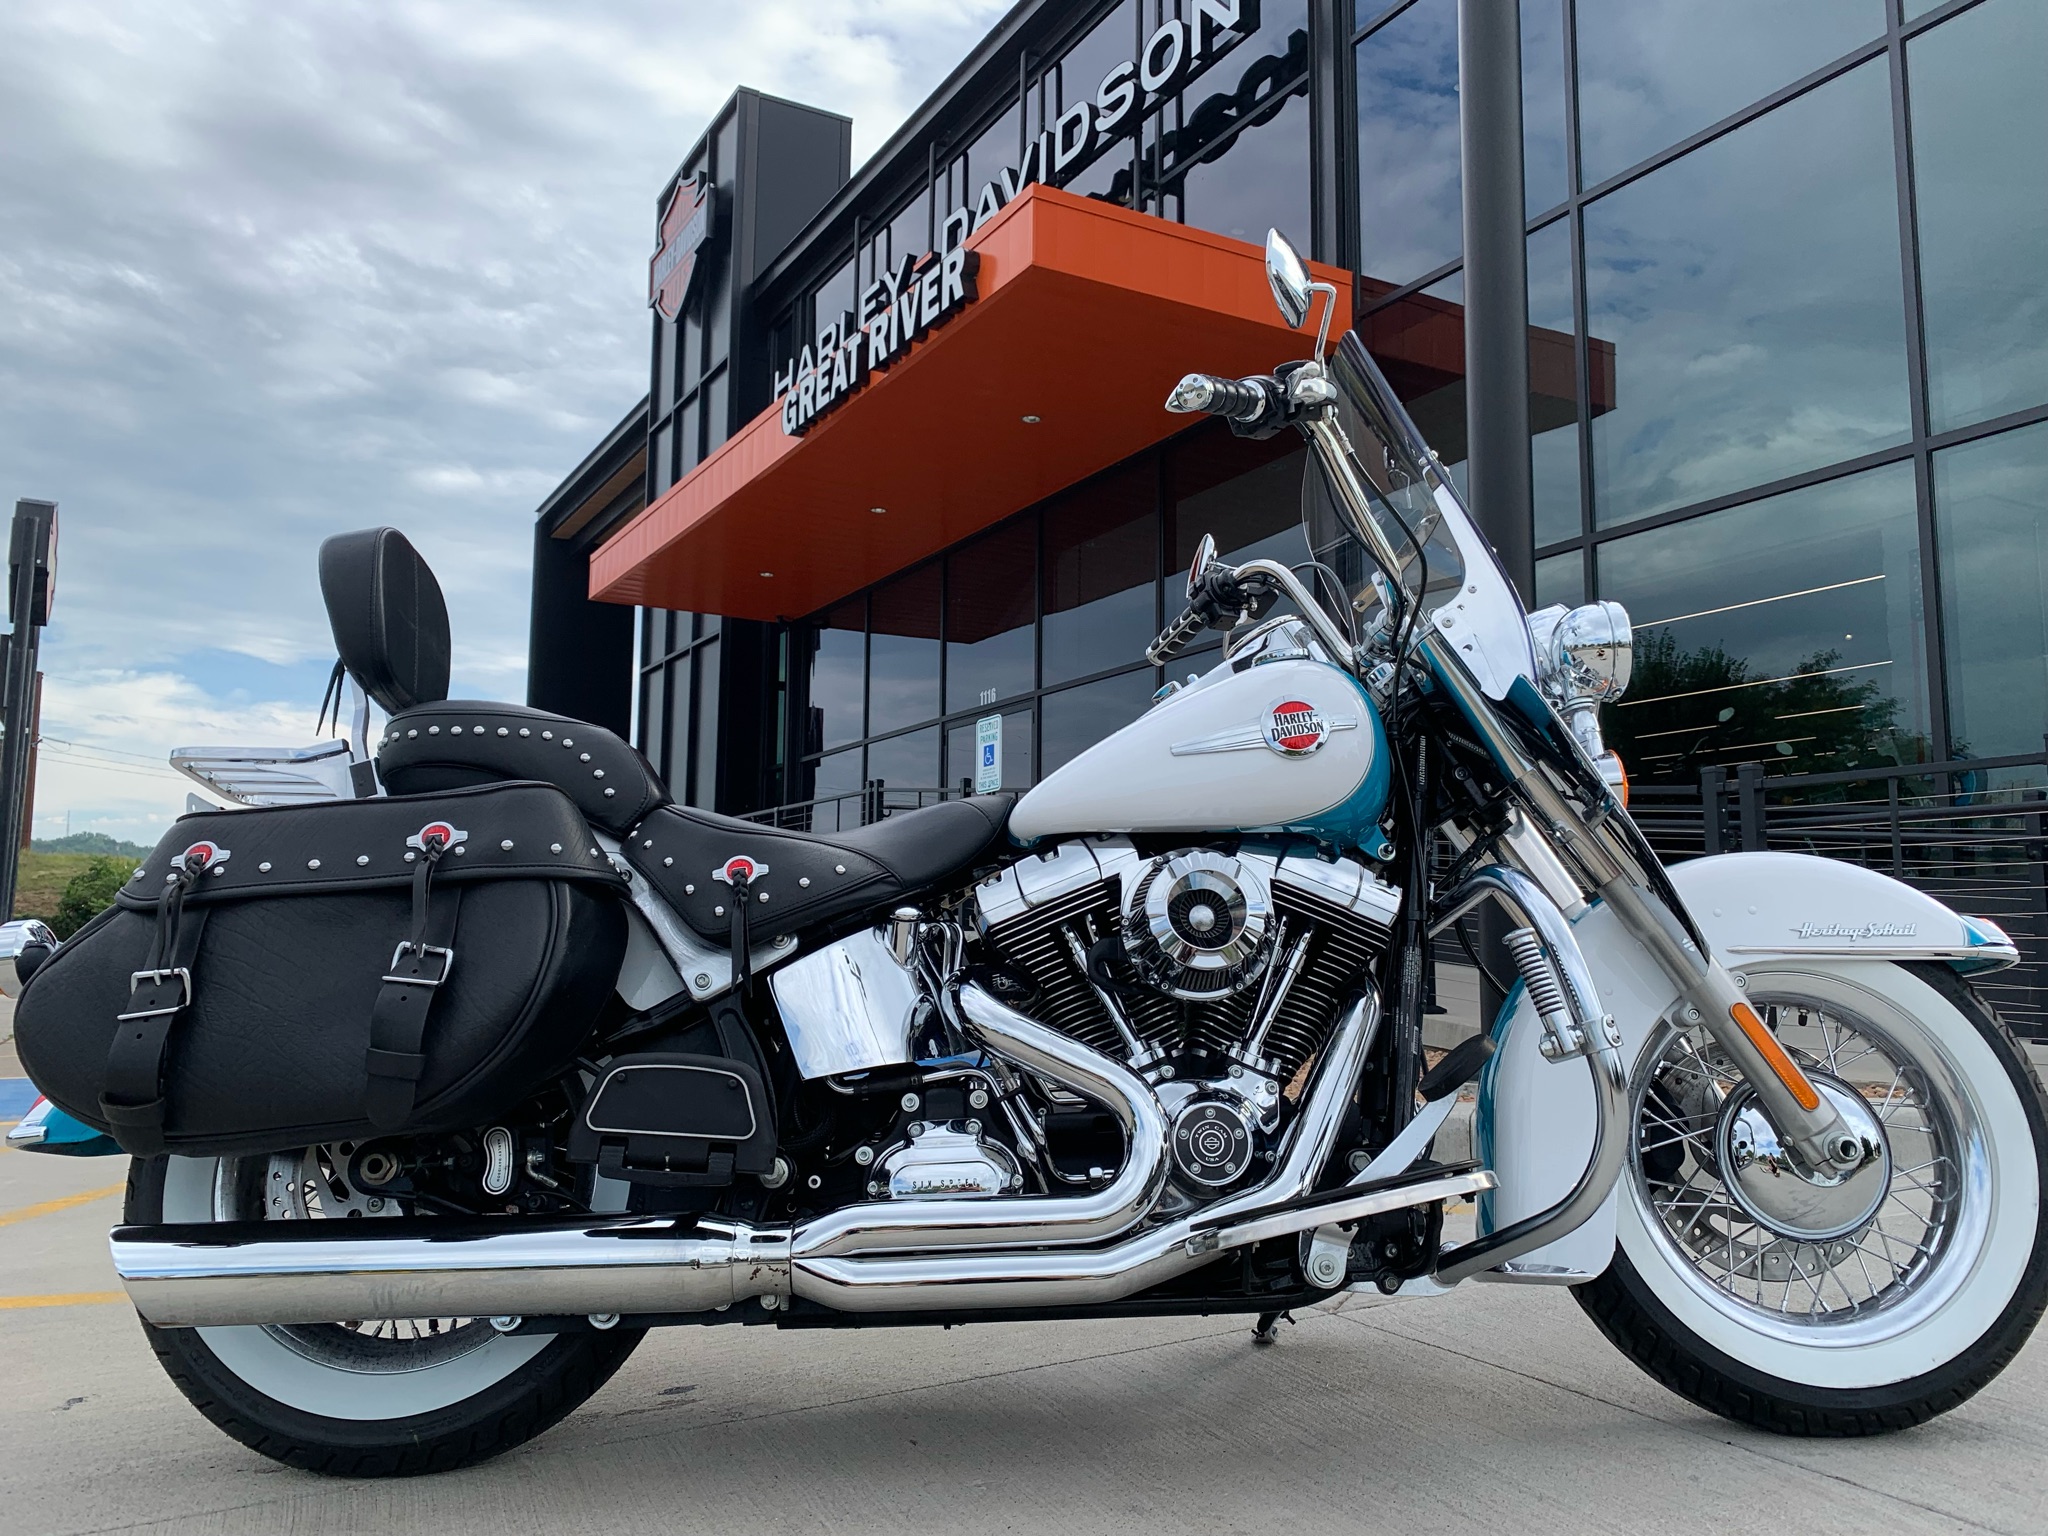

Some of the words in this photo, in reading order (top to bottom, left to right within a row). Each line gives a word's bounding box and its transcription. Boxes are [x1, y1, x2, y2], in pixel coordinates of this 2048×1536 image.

[781, 331, 862, 436] GREAT
[868, 247, 966, 370] RIVER
[980, 688, 996, 705] 1116
[980, 720, 998, 733] RESERVED
[1273, 711, 1319, 727] HARLEY-
[980, 732, 998, 743] PARKING
[1271, 720, 1324, 742] DAVIDSON
[1790, 922, 1868, 942] Heritage
[1867, 922, 1917, 938] Softail
[1194, 1124, 1210, 1138] TWIN
[1214, 1125, 1228, 1139] CAM
[912, 1180, 932, 1190] SIX
[940, 1177, 980, 1188] SPEED
